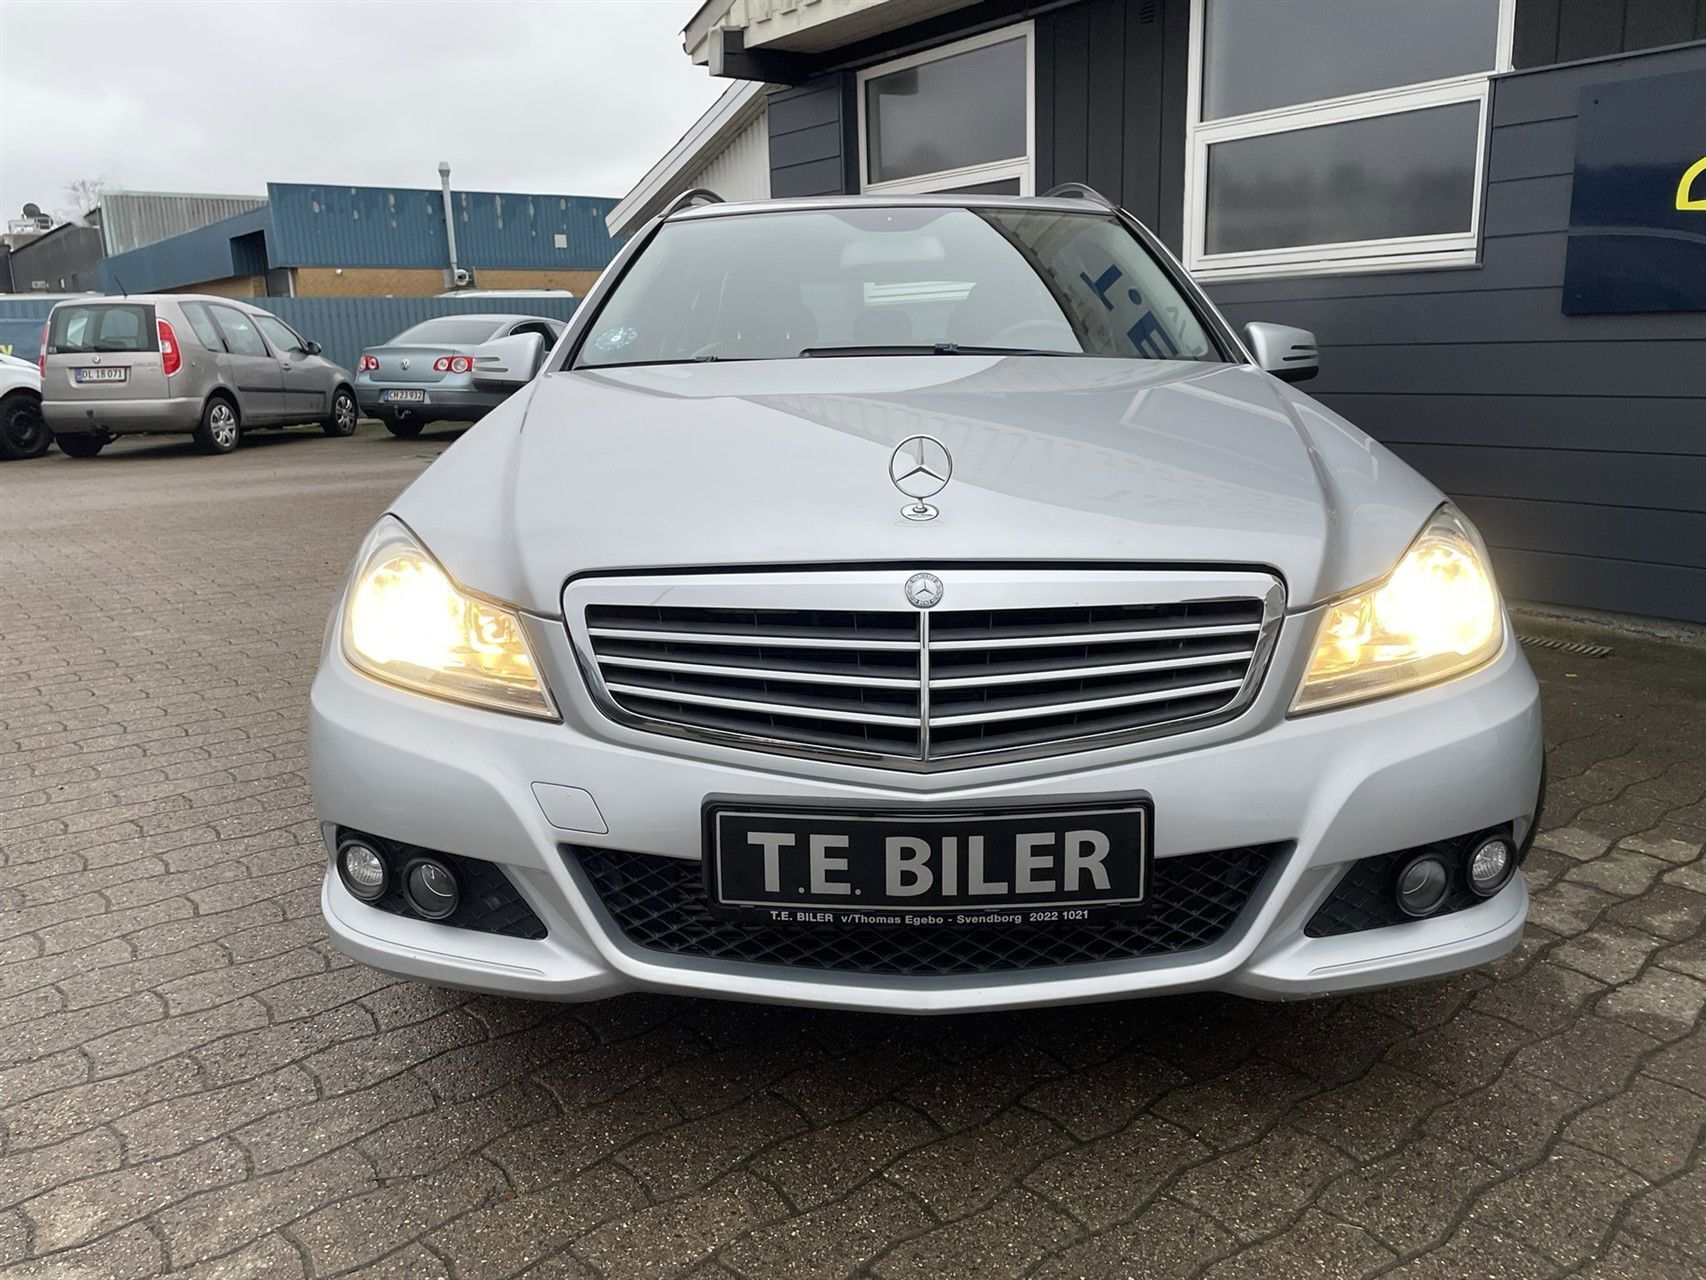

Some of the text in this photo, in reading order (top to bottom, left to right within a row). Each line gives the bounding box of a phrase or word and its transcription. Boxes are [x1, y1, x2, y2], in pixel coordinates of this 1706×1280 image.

[82, 369, 122, 379] DL 18 071
[399, 391, 408, 399] 23
[746, 829, 1112, 897] T.E. BILER
[770, 911, 793, 921] T.E.
[797, 912, 834, 923] BILER
[841, 914, 901, 924] v/Thomas
[905, 915, 944, 926] Egebo
[956, 914, 1022, 924] Svendborg
[1029, 911, 1059, 922] 2022
[1062, 910, 1089, 920] 1021
